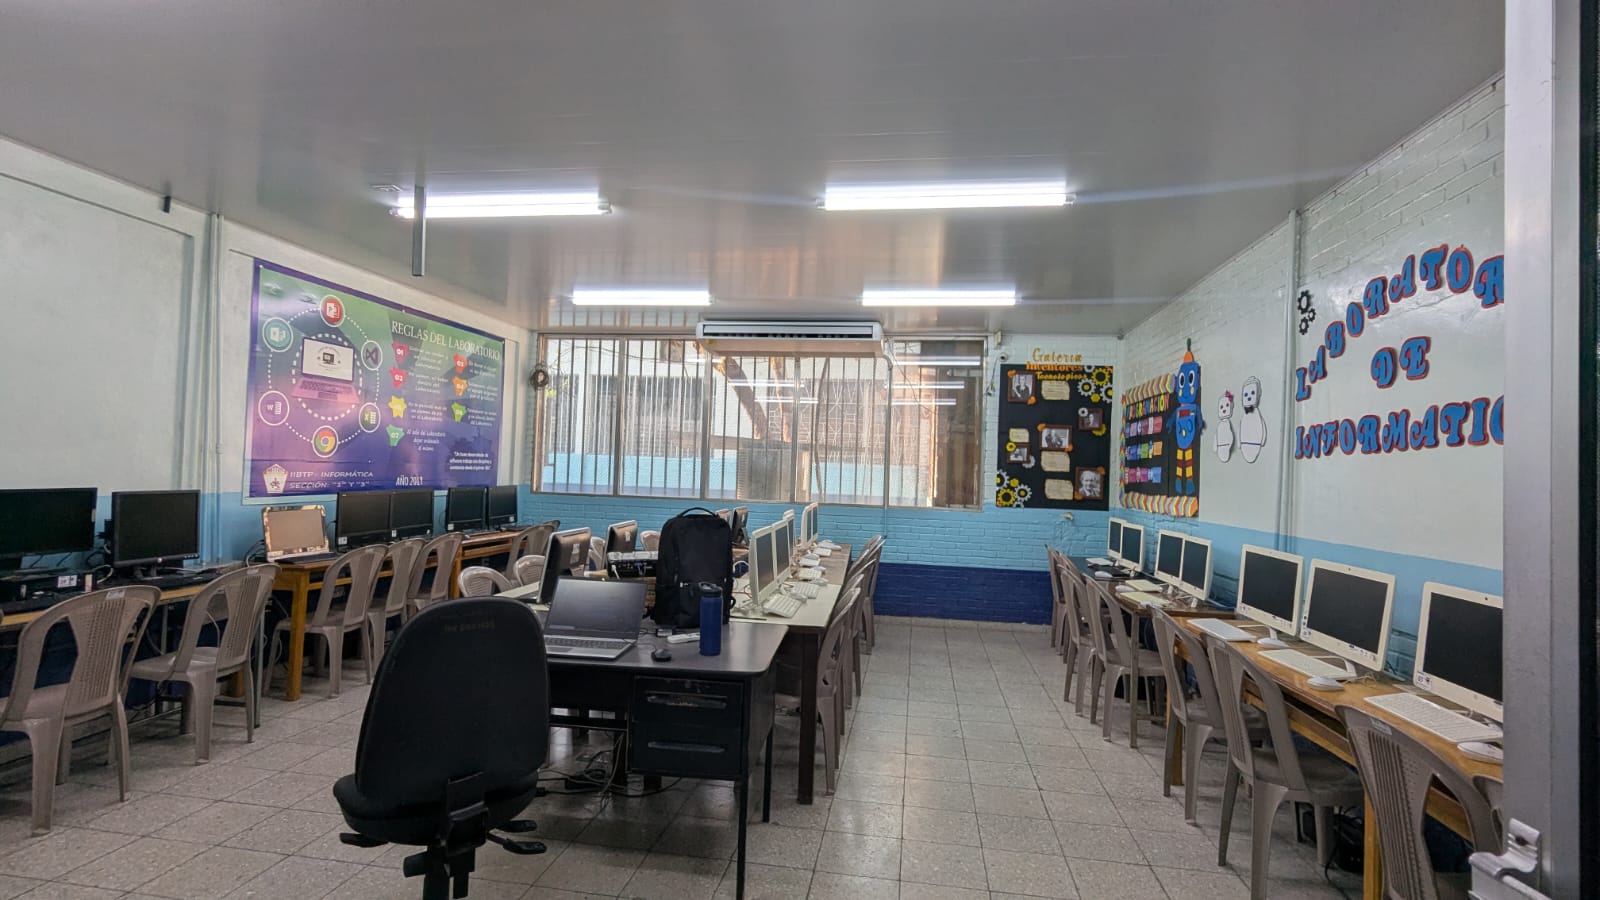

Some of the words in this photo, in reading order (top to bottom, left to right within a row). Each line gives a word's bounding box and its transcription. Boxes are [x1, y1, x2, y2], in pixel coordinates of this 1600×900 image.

[391, 320, 429, 341] REGLAS
[429, 331, 447, 346] DEL
[448, 336, 500, 361] LABORATORIO
[1371, 336, 1431, 389] DE
